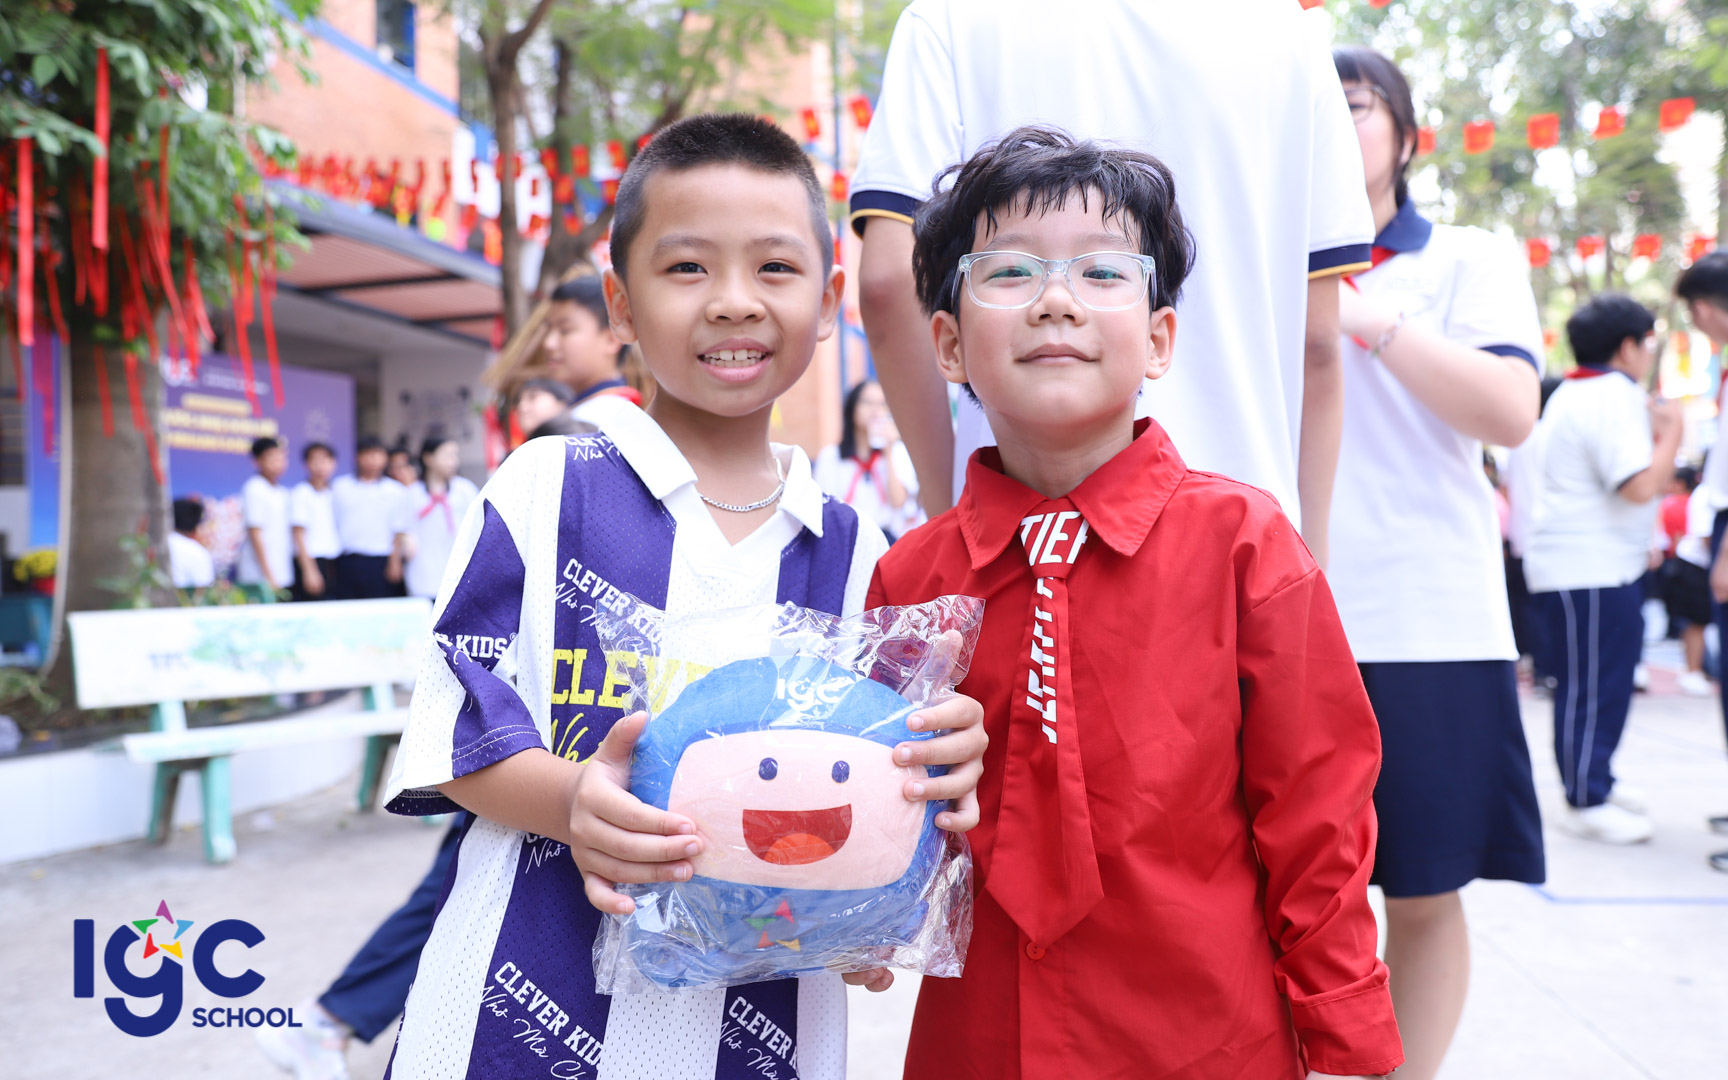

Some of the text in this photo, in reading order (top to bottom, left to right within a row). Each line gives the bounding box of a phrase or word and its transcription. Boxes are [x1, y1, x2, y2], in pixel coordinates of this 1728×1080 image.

[562, 558, 632, 617] CLEVER
[551, 648, 714, 714] CLEV
[494, 961, 603, 1071] CLEVER KID
[728, 996, 793, 1060] CLEVER
